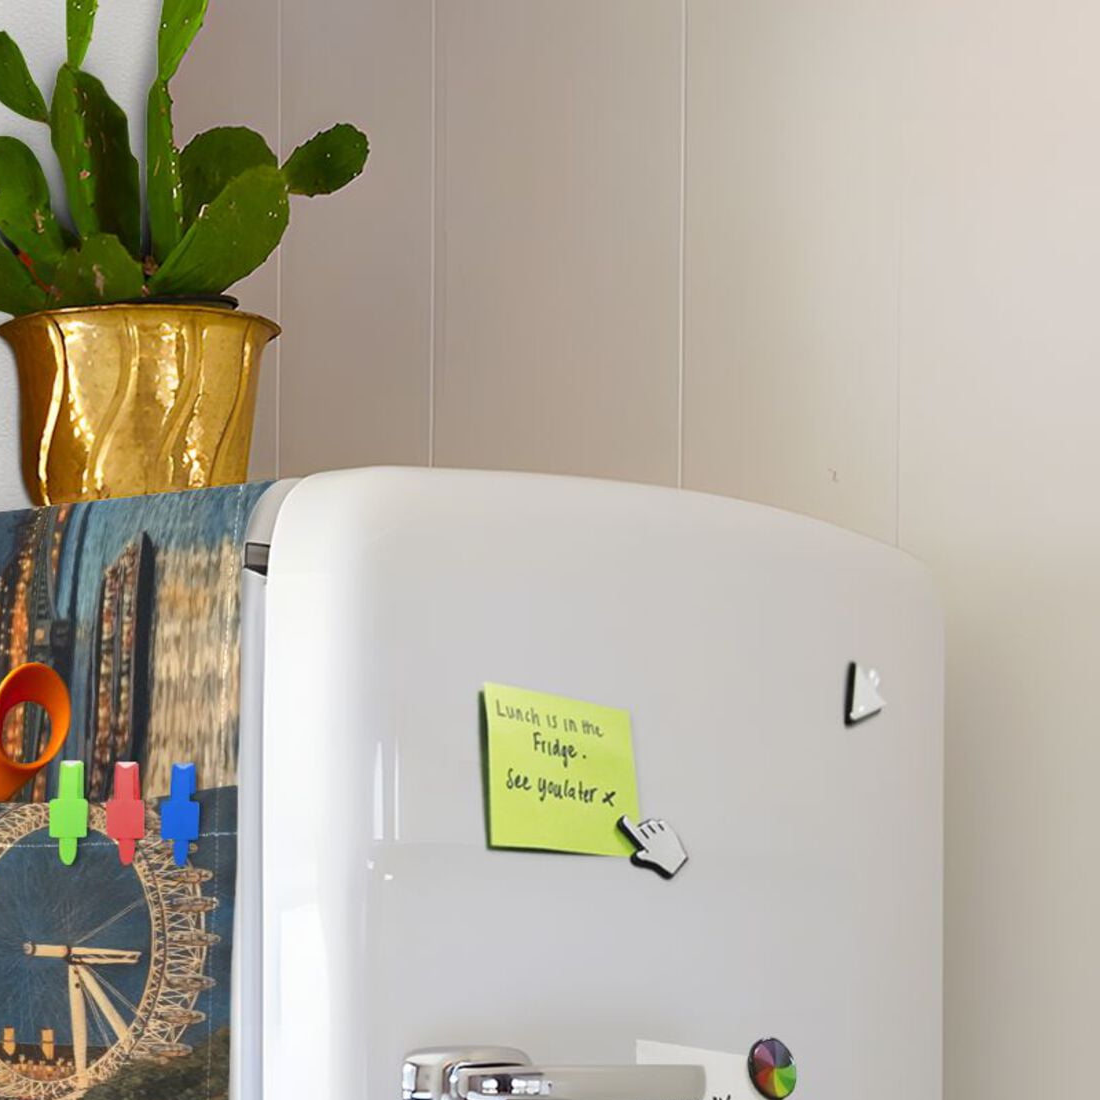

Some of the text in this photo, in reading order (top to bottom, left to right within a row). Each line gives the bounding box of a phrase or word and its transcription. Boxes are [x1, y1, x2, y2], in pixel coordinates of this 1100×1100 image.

[495, 698, 605, 738] Lunch is in the
[506, 767, 532, 791] See
